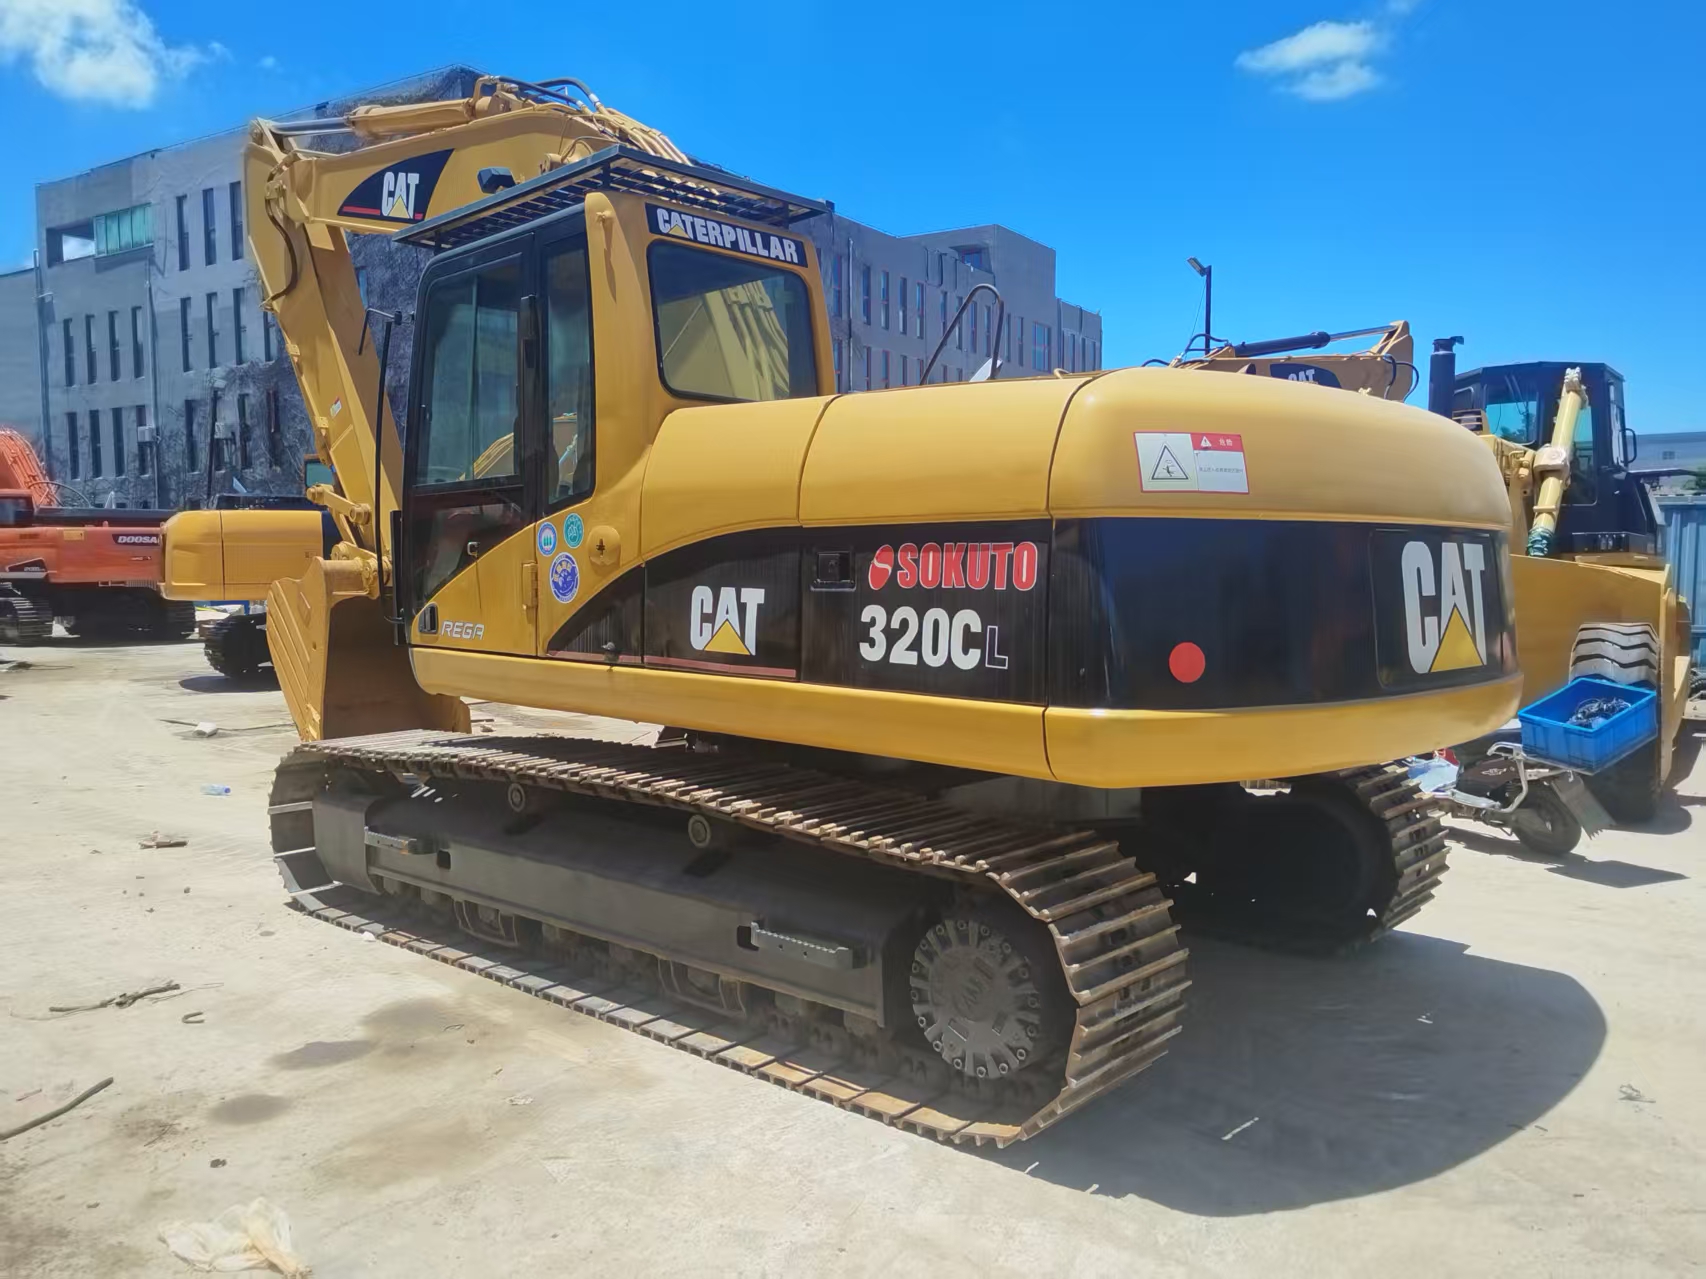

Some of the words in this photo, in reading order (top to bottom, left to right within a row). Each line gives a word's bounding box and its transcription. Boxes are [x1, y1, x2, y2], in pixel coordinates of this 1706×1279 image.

[382, 172, 420, 219] CAT
[656, 208, 799, 264] CATERPILLAR
[117, 535, 160, 544] DOOSA
[897, 541, 1038, 591] SOKUTO
[441, 621, 485, 640] REGA
[690, 585, 765, 656] CAT
[1401, 540, 1488, 674] CAT
